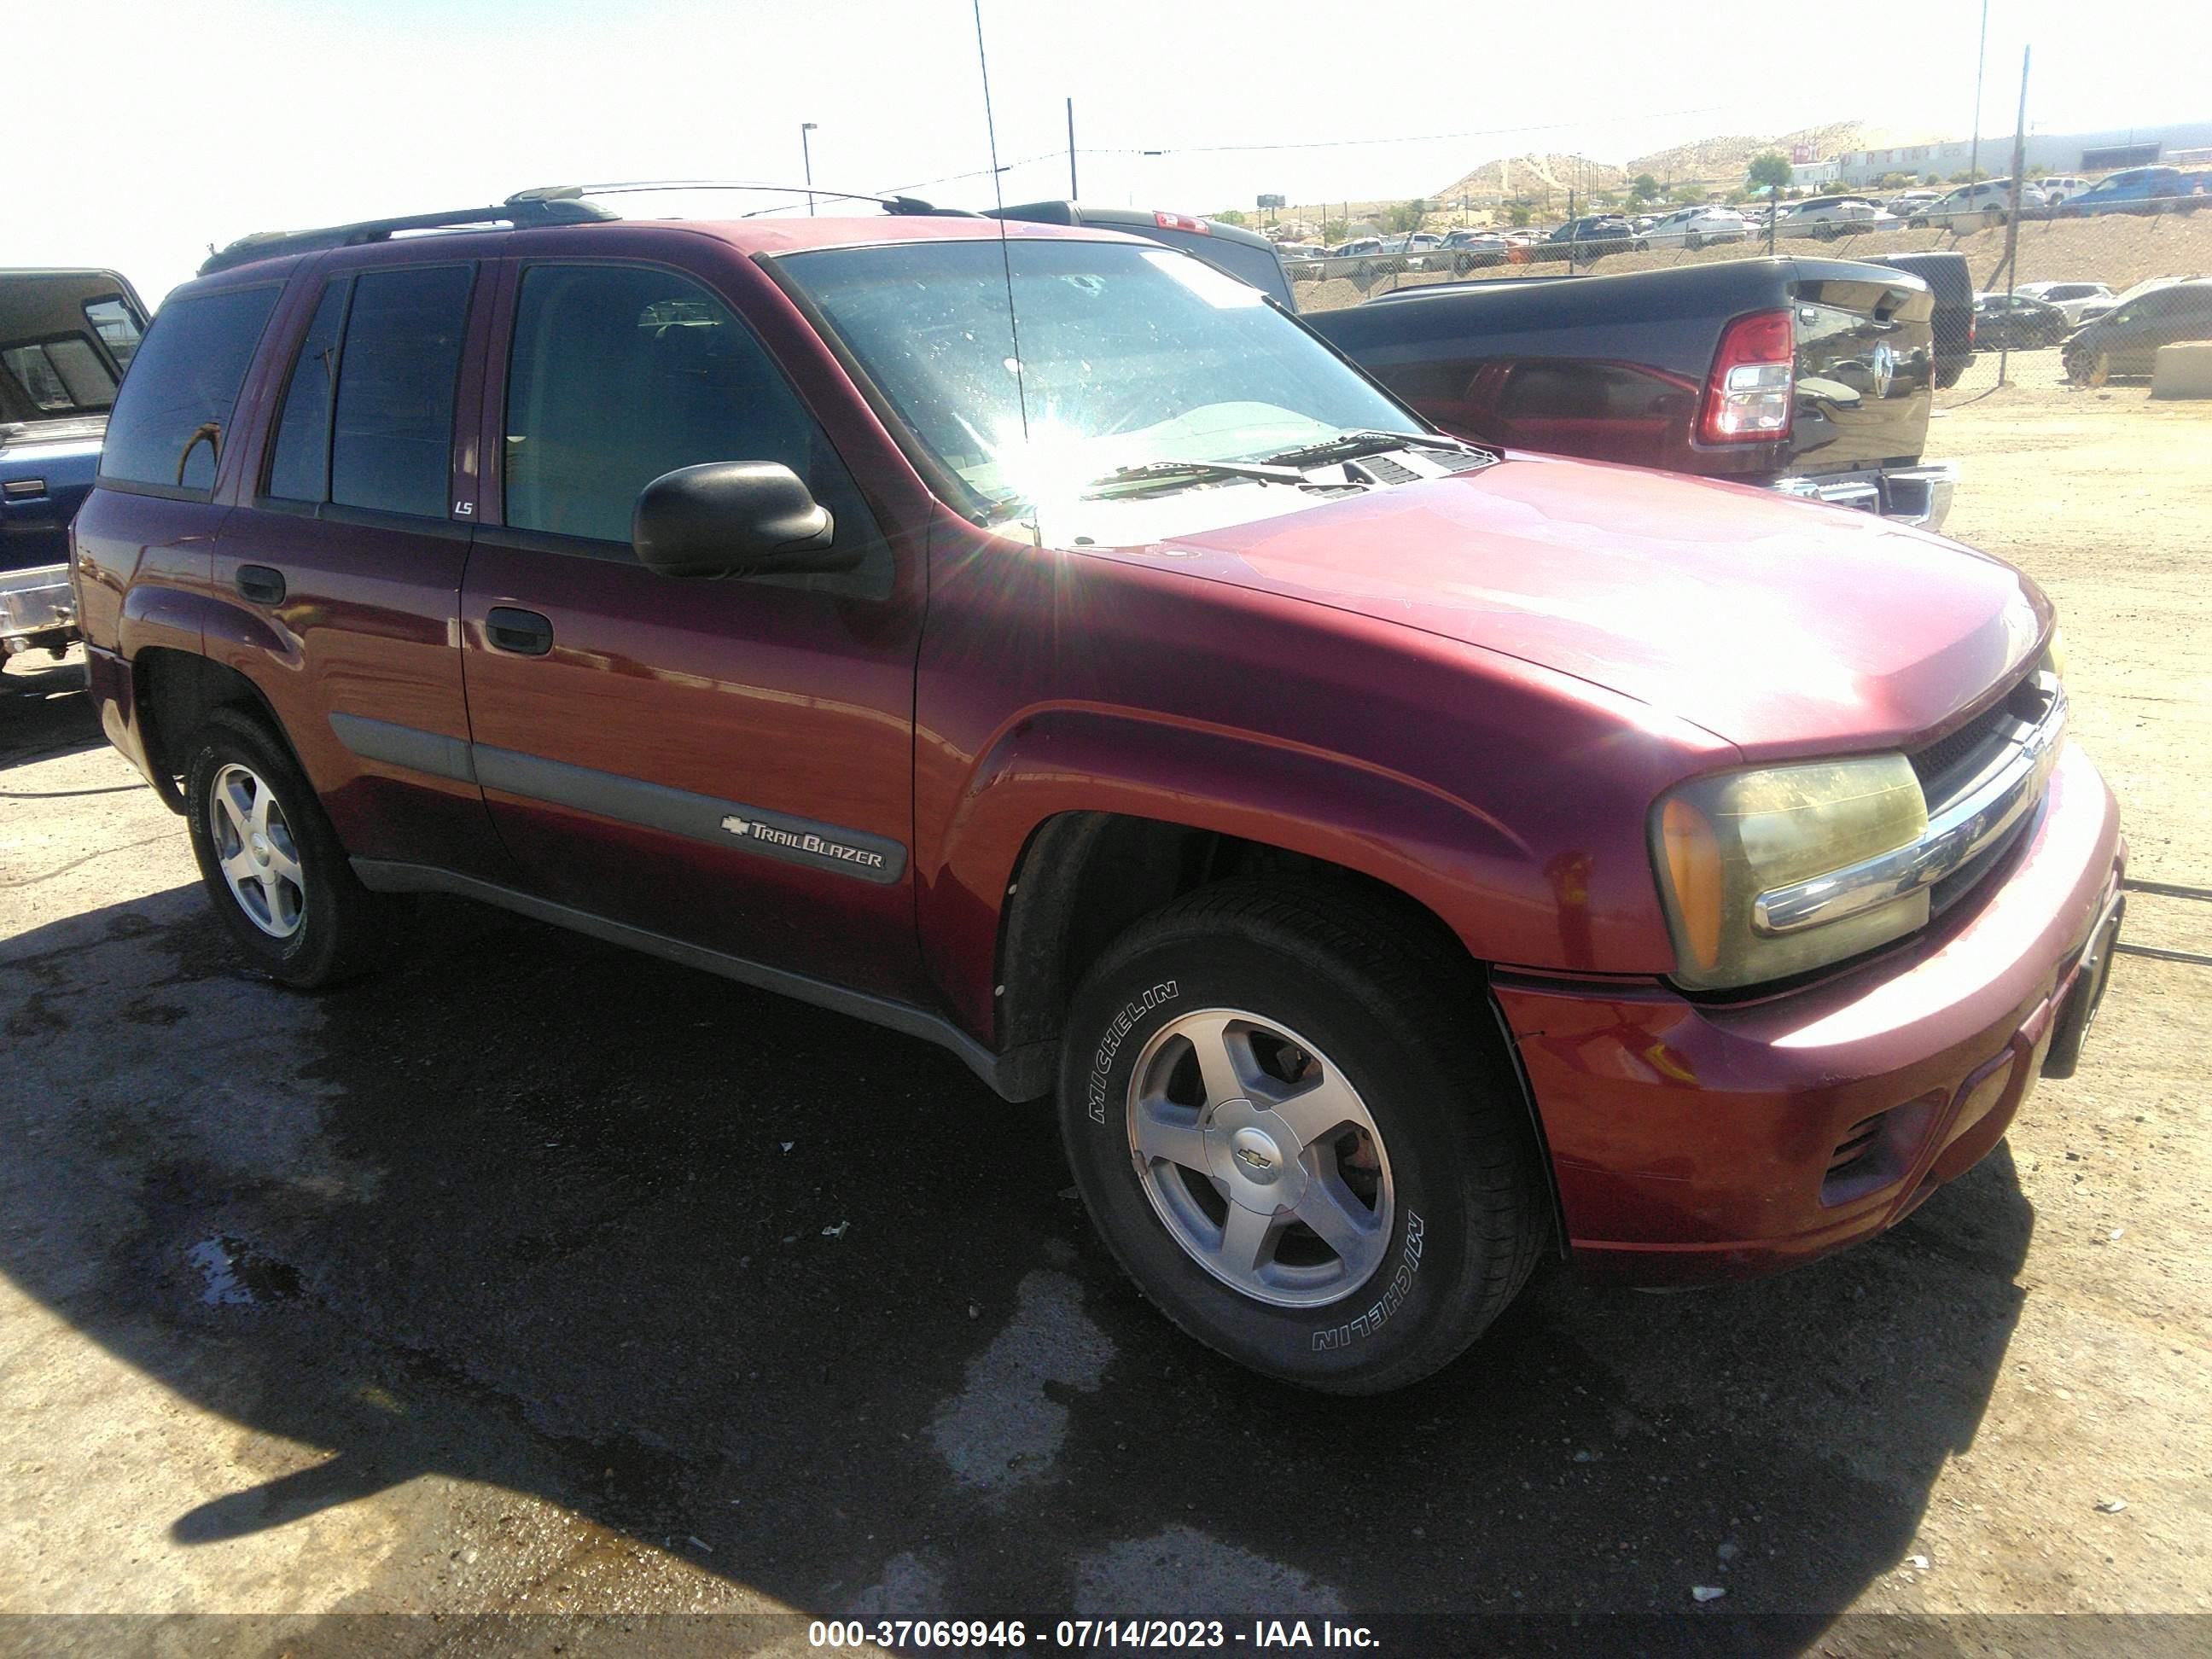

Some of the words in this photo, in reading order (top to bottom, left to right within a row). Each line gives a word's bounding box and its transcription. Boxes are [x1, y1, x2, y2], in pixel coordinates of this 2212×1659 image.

[455, 501, 473, 515] LS
[1089, 980, 1179, 1124] MICHELIN
[1312, 1209, 1424, 1351] MICHELIN
